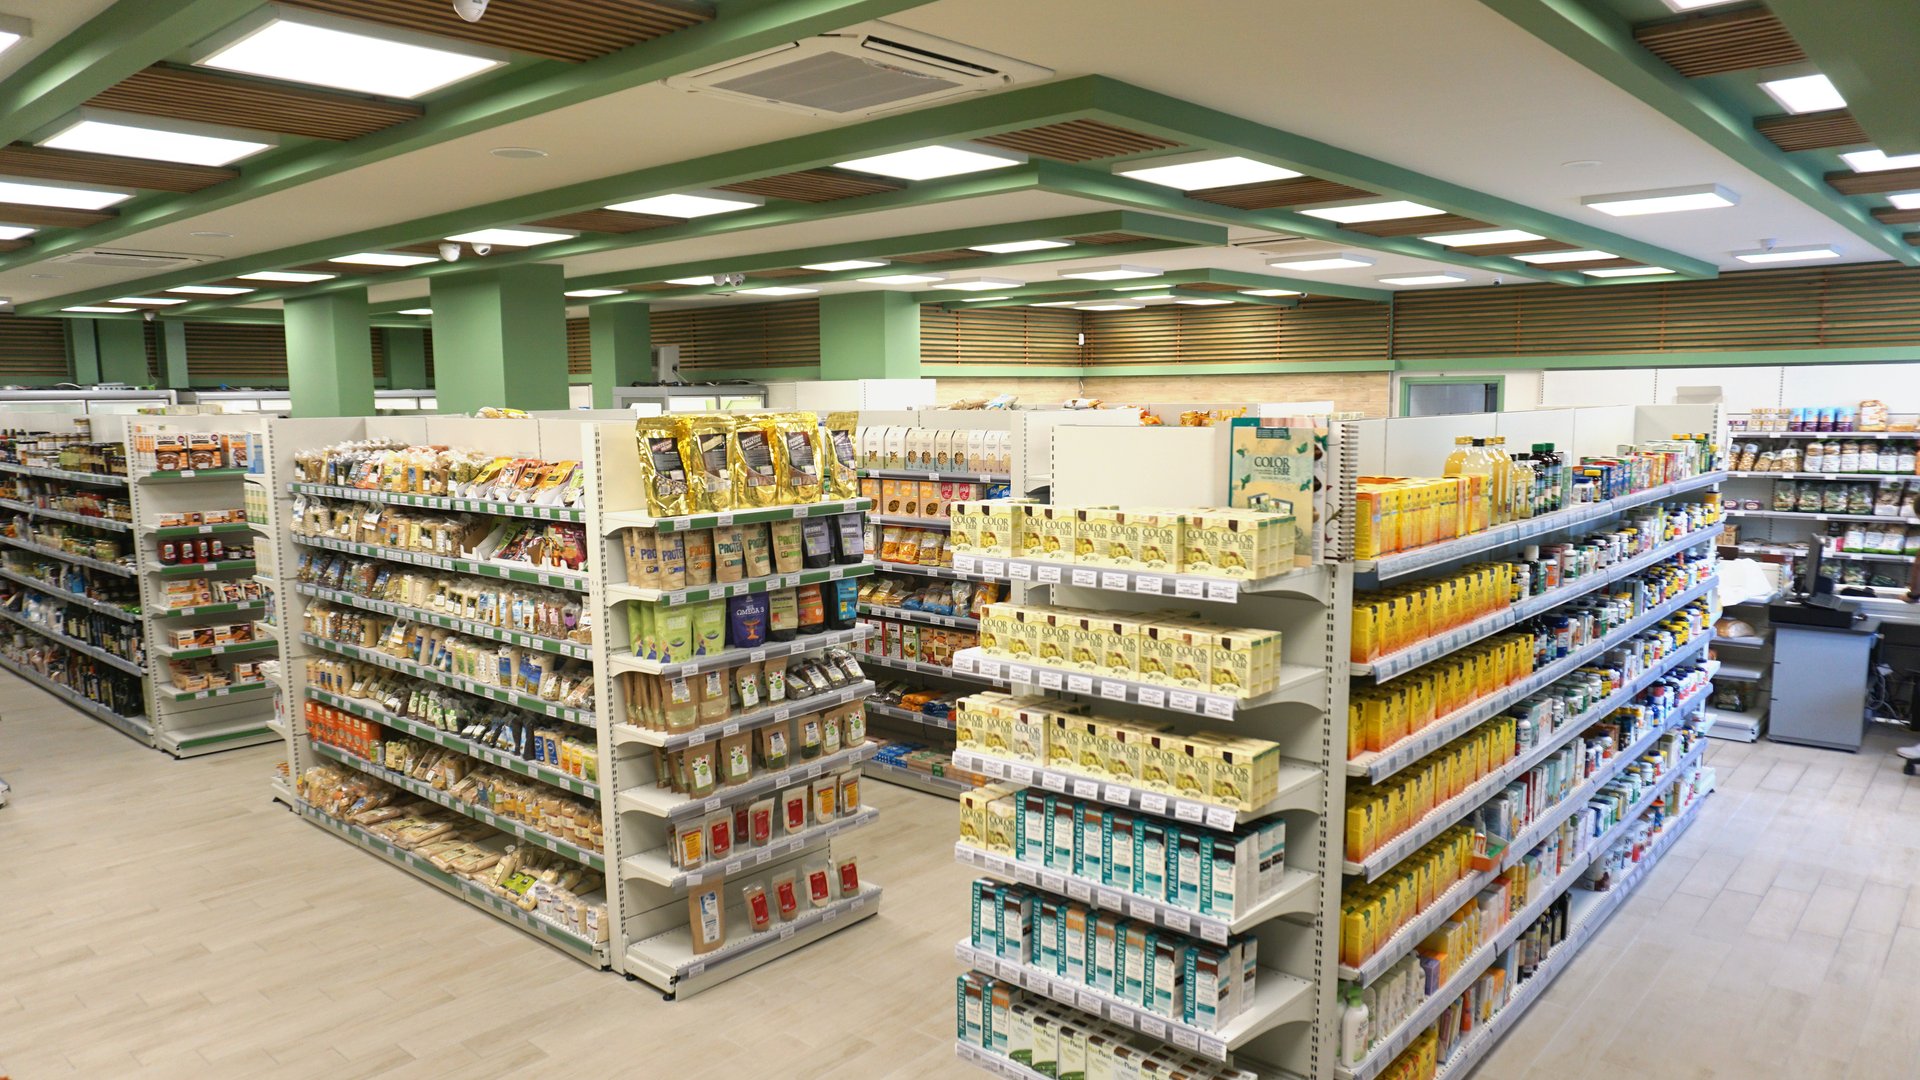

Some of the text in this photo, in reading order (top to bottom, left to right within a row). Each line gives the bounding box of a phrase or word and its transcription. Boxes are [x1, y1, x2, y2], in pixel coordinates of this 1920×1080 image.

[1254, 456, 1290, 468] COLOR
[1273, 467, 1290, 476] ERBE
[952, 516, 977, 526] COLOR
[982, 517, 1009, 526] COLOR
[1045, 520, 1072, 530] COLOR
[1078, 522, 1107, 532] COLOR
[1111, 526, 1138, 536] COLOR
[1142, 528, 1173, 540] COLOR
[1186, 529, 1219, 542] COLOR
[1221, 532, 1254, 544] COLOR
[736, 607, 760, 616] OMEGA
[982, 617, 1007, 627] COLOR
[1011, 622, 1037, 632] COLOR
[1042, 626, 1069, 638] COLOR
[1074, 630, 1102, 641] COLOR
[1108, 634, 1136, 648] COLOR
[1142, 640, 1172, 652] COLOR
[1176, 645, 1208, 659] COLOR
[1214, 650, 1248, 664] COLOR
[958, 712, 983, 722] COLOR
[986, 718, 1012, 728] COLOR
[1015, 724, 1040, 735] COLOR
[1052, 729, 1078, 740] COLOR
[1082, 736, 1110, 746] COLOR
[1111, 742, 1140, 756] COLOR
[1146, 748, 1175, 762] COLOR
[1178, 756, 1210, 770] COLOR
[1216, 764, 1249, 777] COLOR
[1017, 794, 1026, 850] PHARMASTYLE
[1046, 800, 1056, 856] PHARMASTYLE
[1076, 806, 1084, 865] PHARMASTYLE
[1103, 816, 1112, 874] PHARMASTYLE
[1134, 824, 1144, 883] PHARMASTYLE
[1168, 832, 1178, 892] PHARMASTYLE
[1202, 841, 1212, 904] PHARMASTYLE
[974, 884, 982, 938] PHARMASTYLE
[1032, 900, 1041, 956] PHARMASTYLE
[1058, 912, 1066, 968] PHARMASTYLE
[1087, 920, 1096, 976] PHARMASTYLE
[1116, 930, 1126, 986] PHARMASTYLE
[1145, 940, 1154, 998] PHARMASTYLE
[1185, 954, 1195, 1013] PHARMASTYLE
[958, 980, 966, 1030] PHARMASTYLE
[984, 990, 992, 1040] PHARMASTYLE
